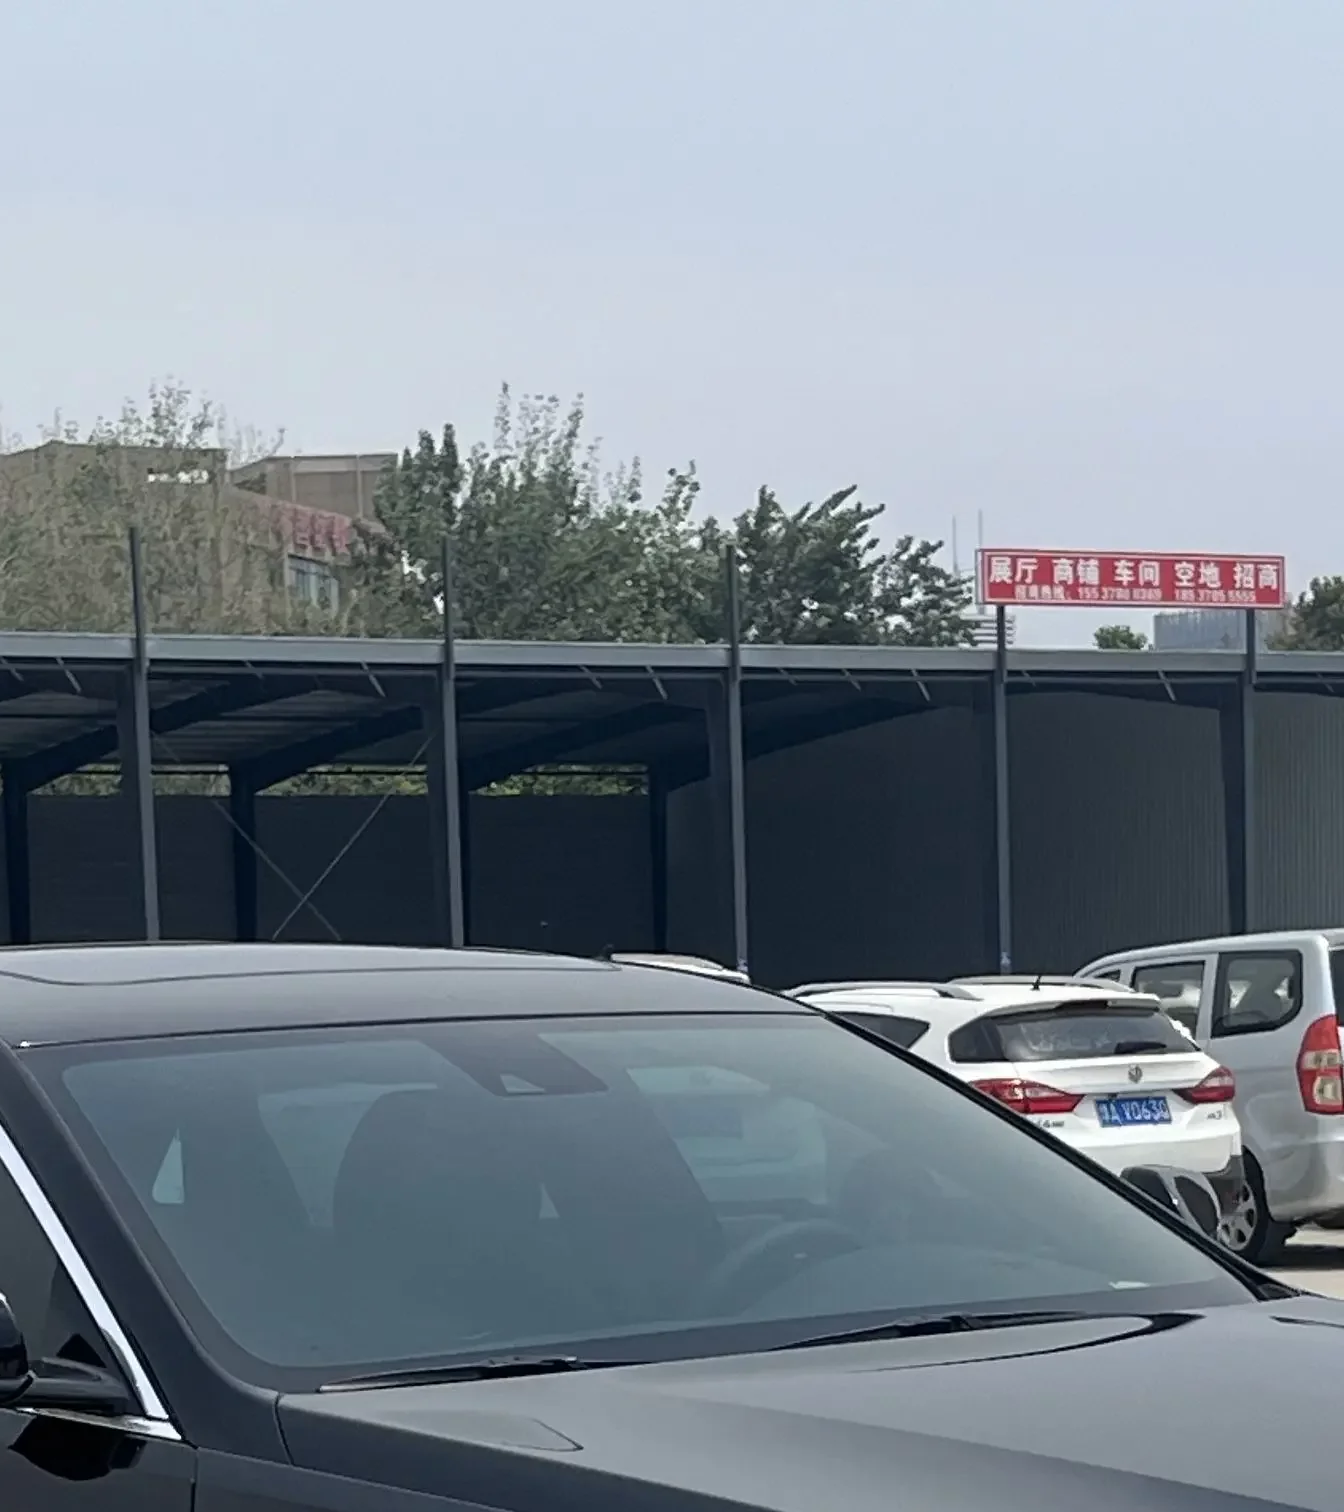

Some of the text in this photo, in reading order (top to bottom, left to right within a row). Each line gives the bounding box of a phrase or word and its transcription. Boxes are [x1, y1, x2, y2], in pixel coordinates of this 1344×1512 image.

[989, 556, 1038, 584] 展厅
[1114, 560, 1160, 586] 车间
[1174, 561, 1222, 588] 空地
[1233, 562, 1278, 590] 招商
